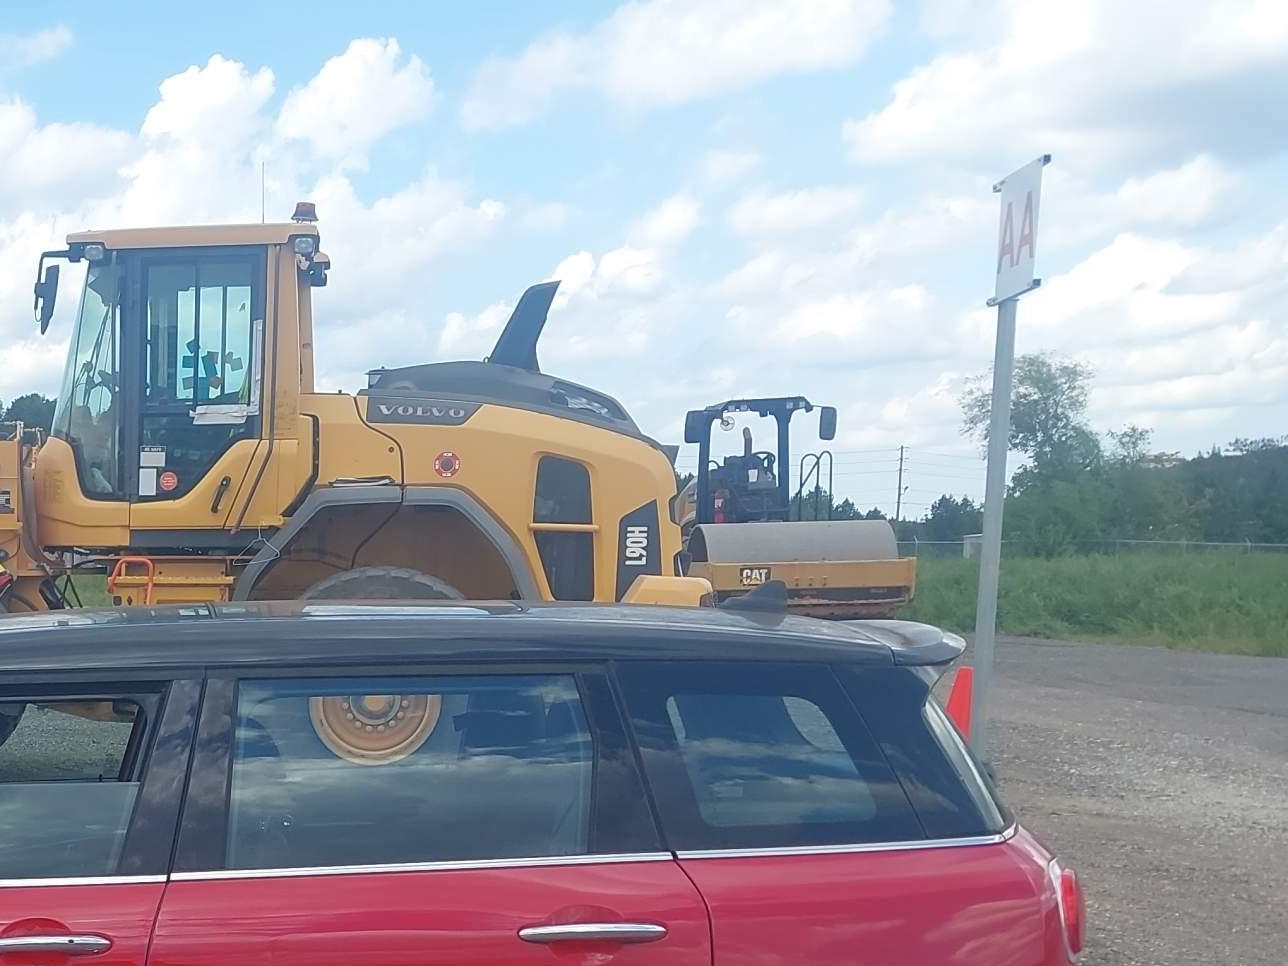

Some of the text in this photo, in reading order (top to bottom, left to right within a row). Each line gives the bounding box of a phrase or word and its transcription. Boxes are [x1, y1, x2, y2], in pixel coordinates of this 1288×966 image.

[997, 191, 1034, 275] AA
[378, 404, 465, 418] VOLVO
[625, 526, 649, 566] L90H
[742, 568, 769, 585] CAT
